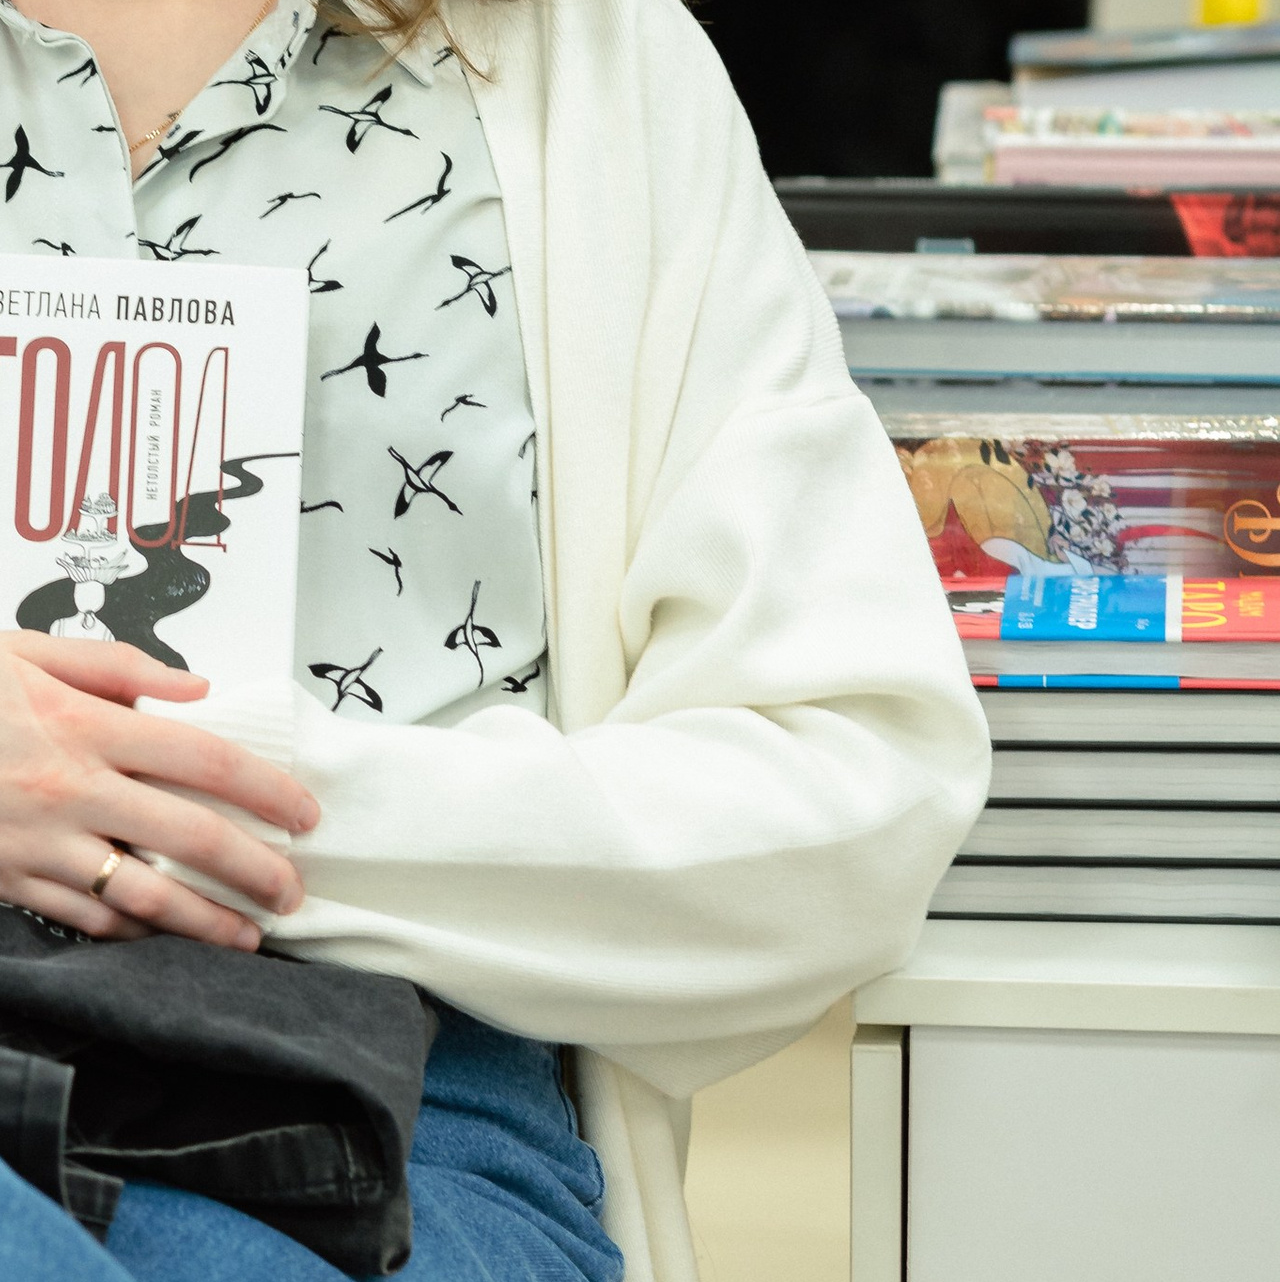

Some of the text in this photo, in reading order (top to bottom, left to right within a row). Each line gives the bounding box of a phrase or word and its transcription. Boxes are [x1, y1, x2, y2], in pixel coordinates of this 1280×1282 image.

[116, 294, 235, 326] ПАВЛОВА
[145, 388, 163, 501] НЕТОЛСТЫЙ РОМАН
